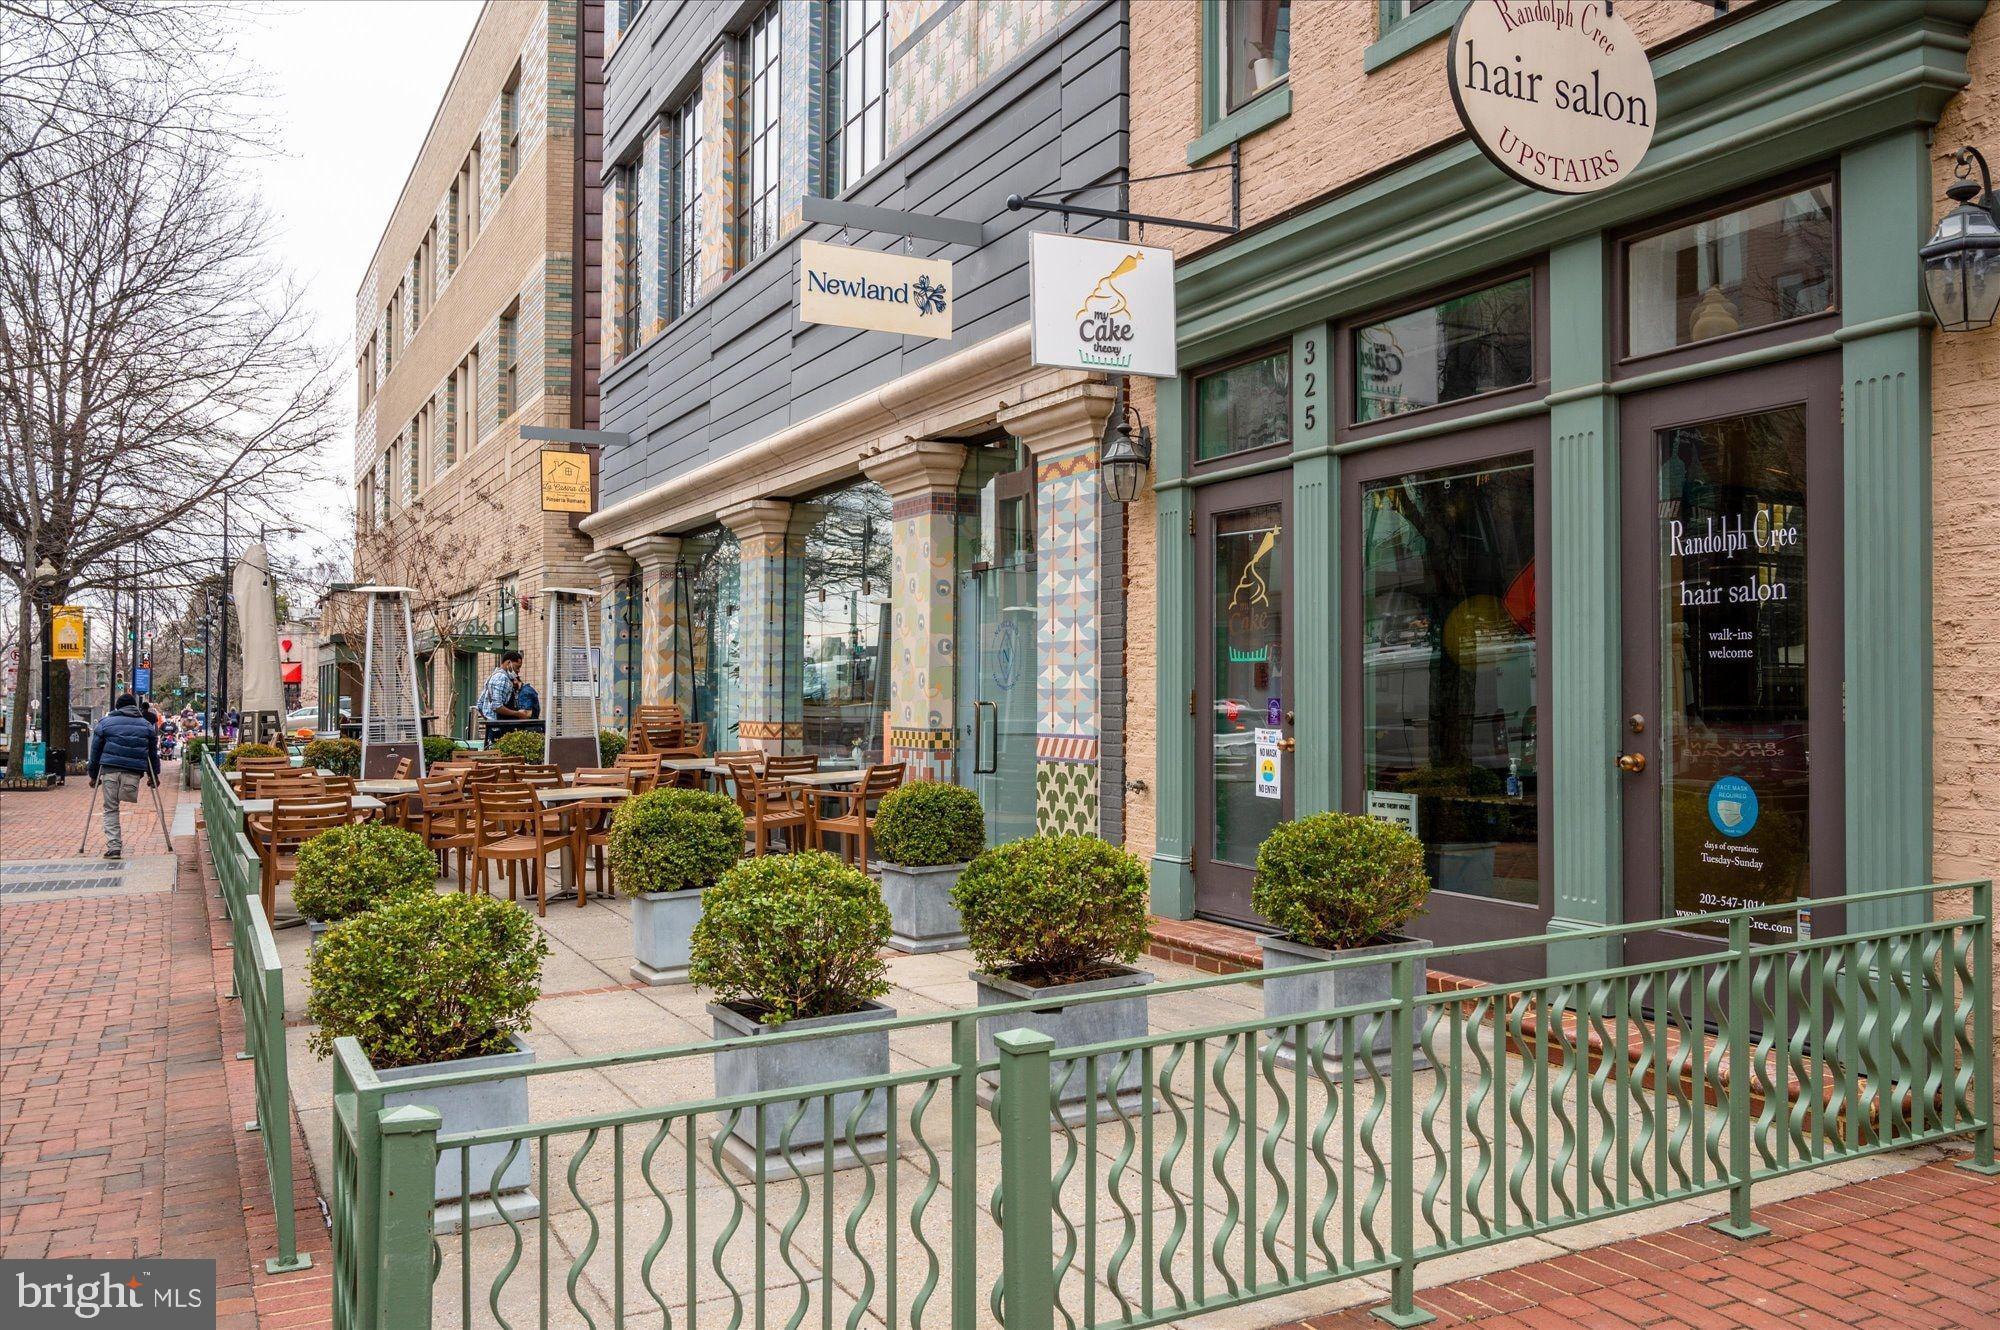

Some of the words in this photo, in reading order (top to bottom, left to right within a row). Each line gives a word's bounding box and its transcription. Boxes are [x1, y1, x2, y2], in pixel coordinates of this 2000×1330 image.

[1493, 0, 1574, 33] Randolph
[1581, 3, 1615, 56] Cree
[1464, 39, 1543, 104] hair
[1555, 69, 1650, 128] salon
[1499, 125, 1619, 182] UPSTAIRS
[808, 269, 909, 304] Newland
[1094, 311, 1109, 323] my
[1079, 318, 1135, 342] Cake
[1093, 342, 1122, 356] theory
[1669, 513, 1748, 559] Randolph
[1753, 509, 1798, 548] Cree
[1679, 580, 1723, 606] hair
[1728, 574, 1788, 604] salon
[1708, 628, 1753, 641] walk-ins
[1708, 646, 1753, 659] welcome
[1259, 749, 1265, 757] NO
[1266, 749, 1278, 758] MASK
[1258, 784, 1265, 793] NO
[1265, 785, 1278, 795] ENTRY
[1704, 840, 1719, 852] days
[1719, 842, 1727, 850] of
[1726, 844, 1759, 854] operation:
[1700, 852, 1764, 872] Tuesday-Sunday
